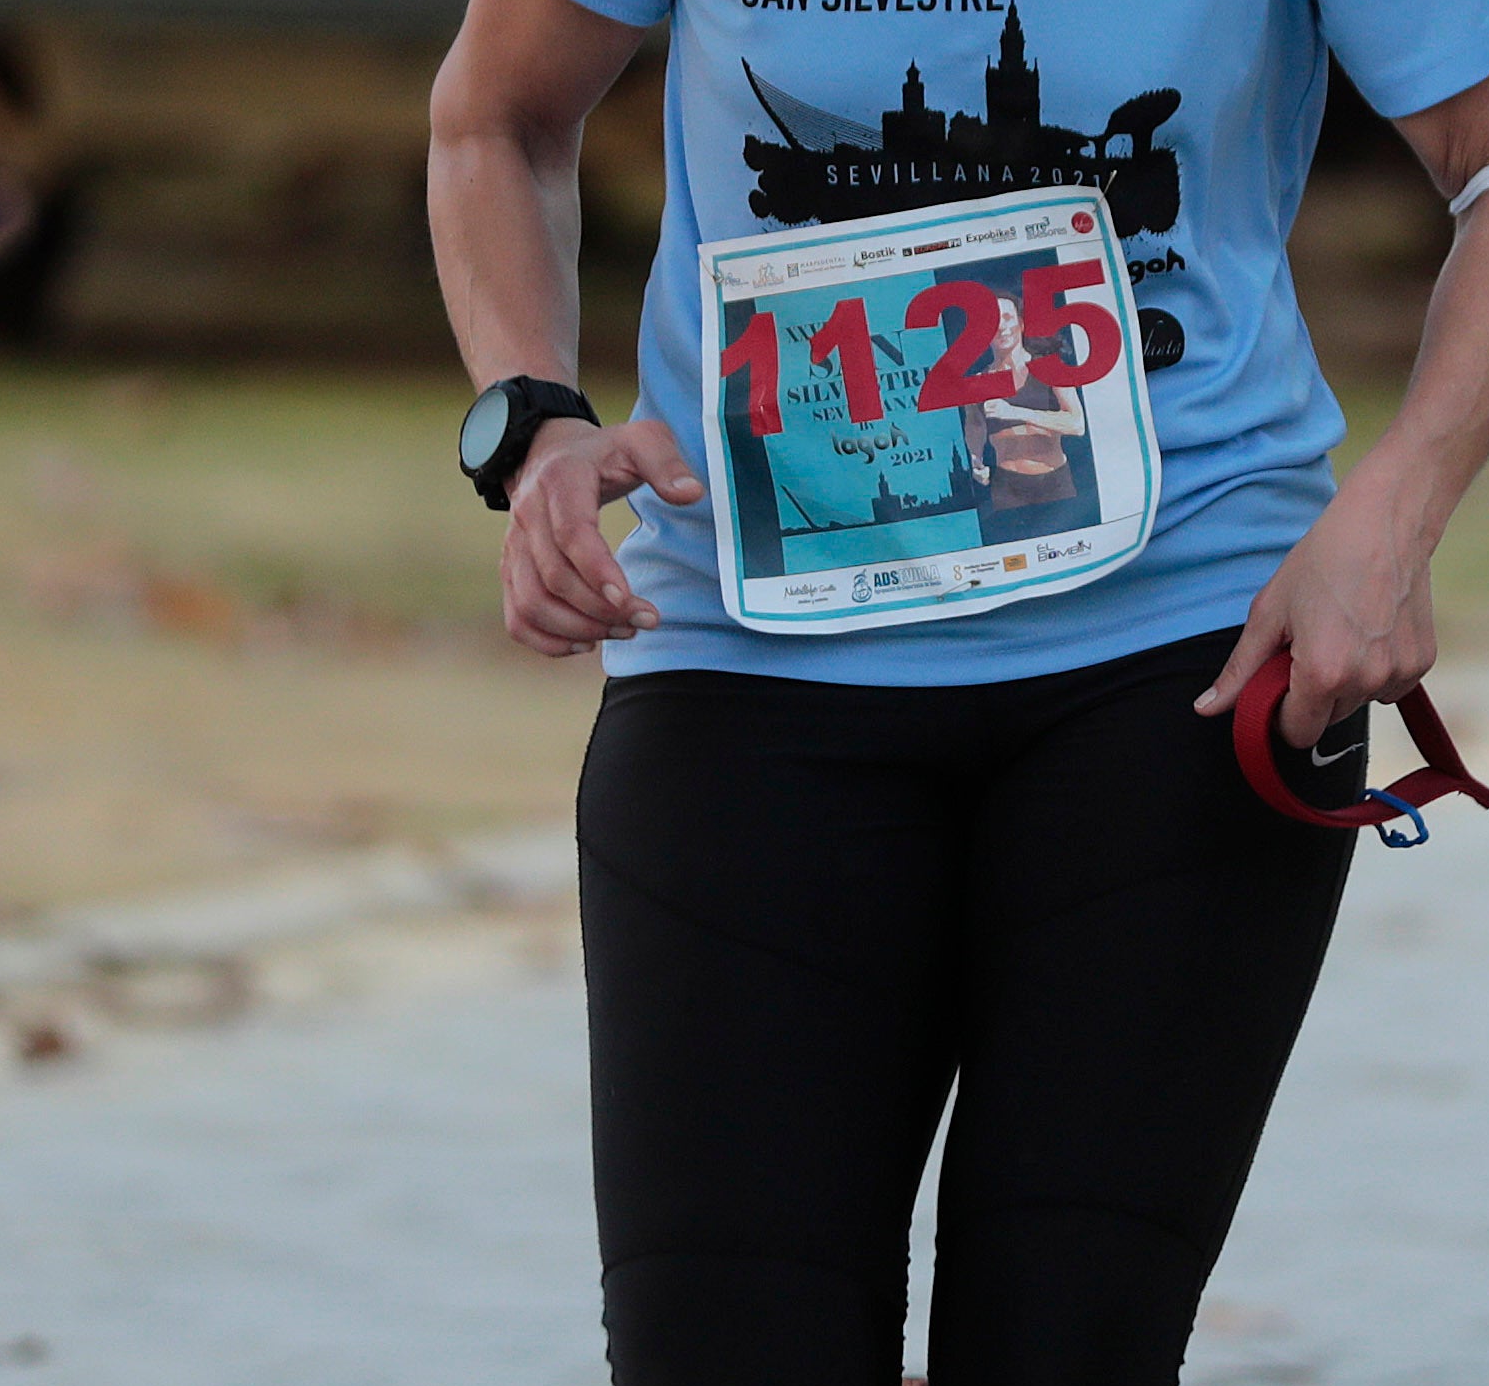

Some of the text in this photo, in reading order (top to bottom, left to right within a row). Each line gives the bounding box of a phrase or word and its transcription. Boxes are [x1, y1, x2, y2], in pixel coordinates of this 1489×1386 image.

[827, 162, 1101, 188] SEVILLANA 2021
[861, 247, 896, 261] Bostik
[720, 258, 1122, 437] 1125
[890, 447, 934, 467] 2021
